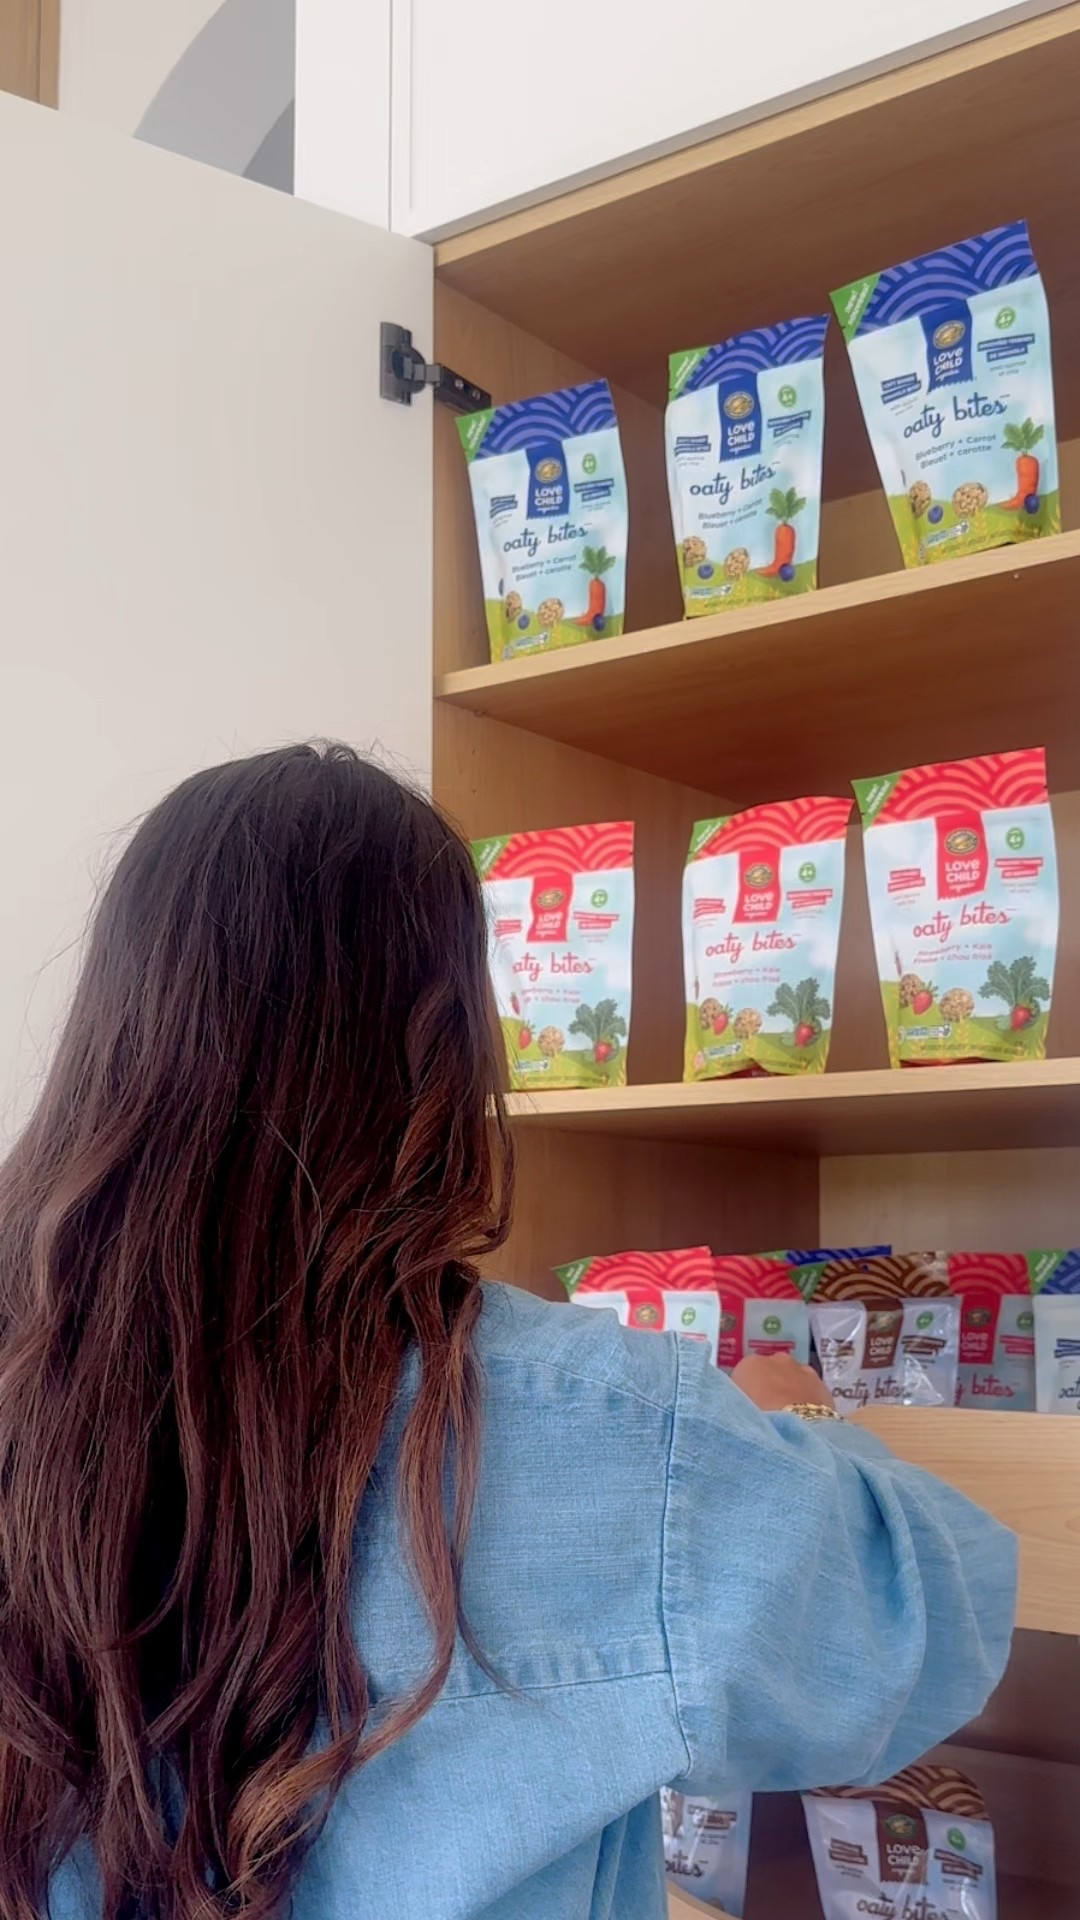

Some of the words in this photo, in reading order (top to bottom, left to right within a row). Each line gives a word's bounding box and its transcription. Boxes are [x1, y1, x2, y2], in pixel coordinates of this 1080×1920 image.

[934, 357, 964, 375] CHILD
[903, 404, 945, 438] oaty
[953, 392, 1008, 421] bites
[727, 432, 755, 446] CHILD
[915, 439, 956, 461] Blueberry
[966, 434, 997, 444] Carrot
[920, 454, 947, 469] Bleuet
[957, 445, 992, 456] carotte
[689, 472, 733, 506] oaty
[741, 463, 776, 490] bites
[534, 496, 563, 507] CHILD
[503, 528, 541, 557] oaty
[547, 522, 588, 544] bites
[945, 871, 980, 883] CHILD
[913, 910, 954, 943] oaty
[960, 901, 1010, 926] bites
[705, 932, 744, 964] oaty
[752, 930, 796, 951] bites
[512, 952, 543, 982] aty
[551, 952, 593, 973] bites
[972, 1373, 1015, 1397] bites
